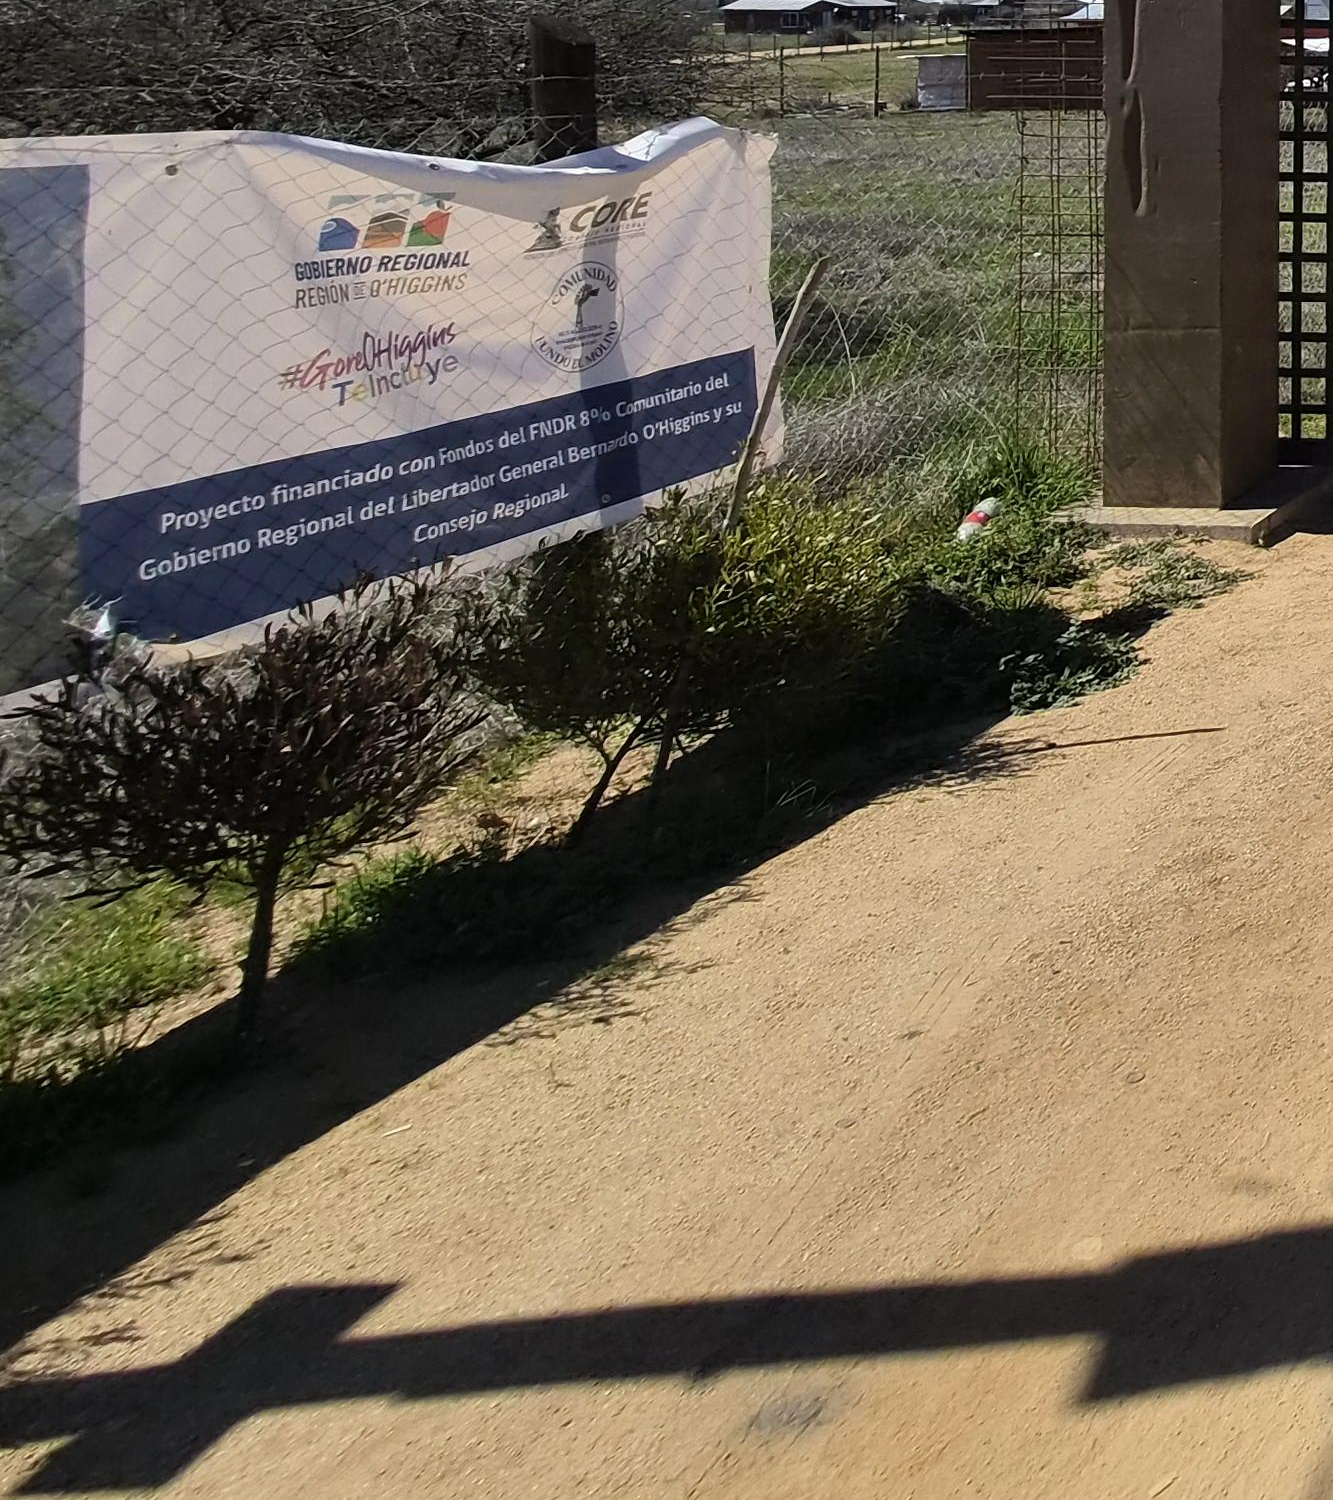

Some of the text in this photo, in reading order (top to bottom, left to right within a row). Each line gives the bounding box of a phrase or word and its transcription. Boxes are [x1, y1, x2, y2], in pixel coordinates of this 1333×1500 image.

[569, 191, 653, 233] CORE
[294, 250, 471, 281] GOBIERNO REGIONAL
[551, 267, 618, 306] COMUNIDAD
[294, 273, 468, 310] REGIÓN DE O'HIGGINS
[535, 336, 571, 369] FUNDO
[572, 354, 584, 370] EL
[585, 320, 619, 366] MOLINO
[160, 373, 730, 534] Proyecto financiado con Fondos del FNDR 8% Comunitario del
[138, 400, 743, 581] Gobierno Regional del Libertador General Bernardo O'Higgins y su
[413, 483, 570, 543] Consejo Regional
